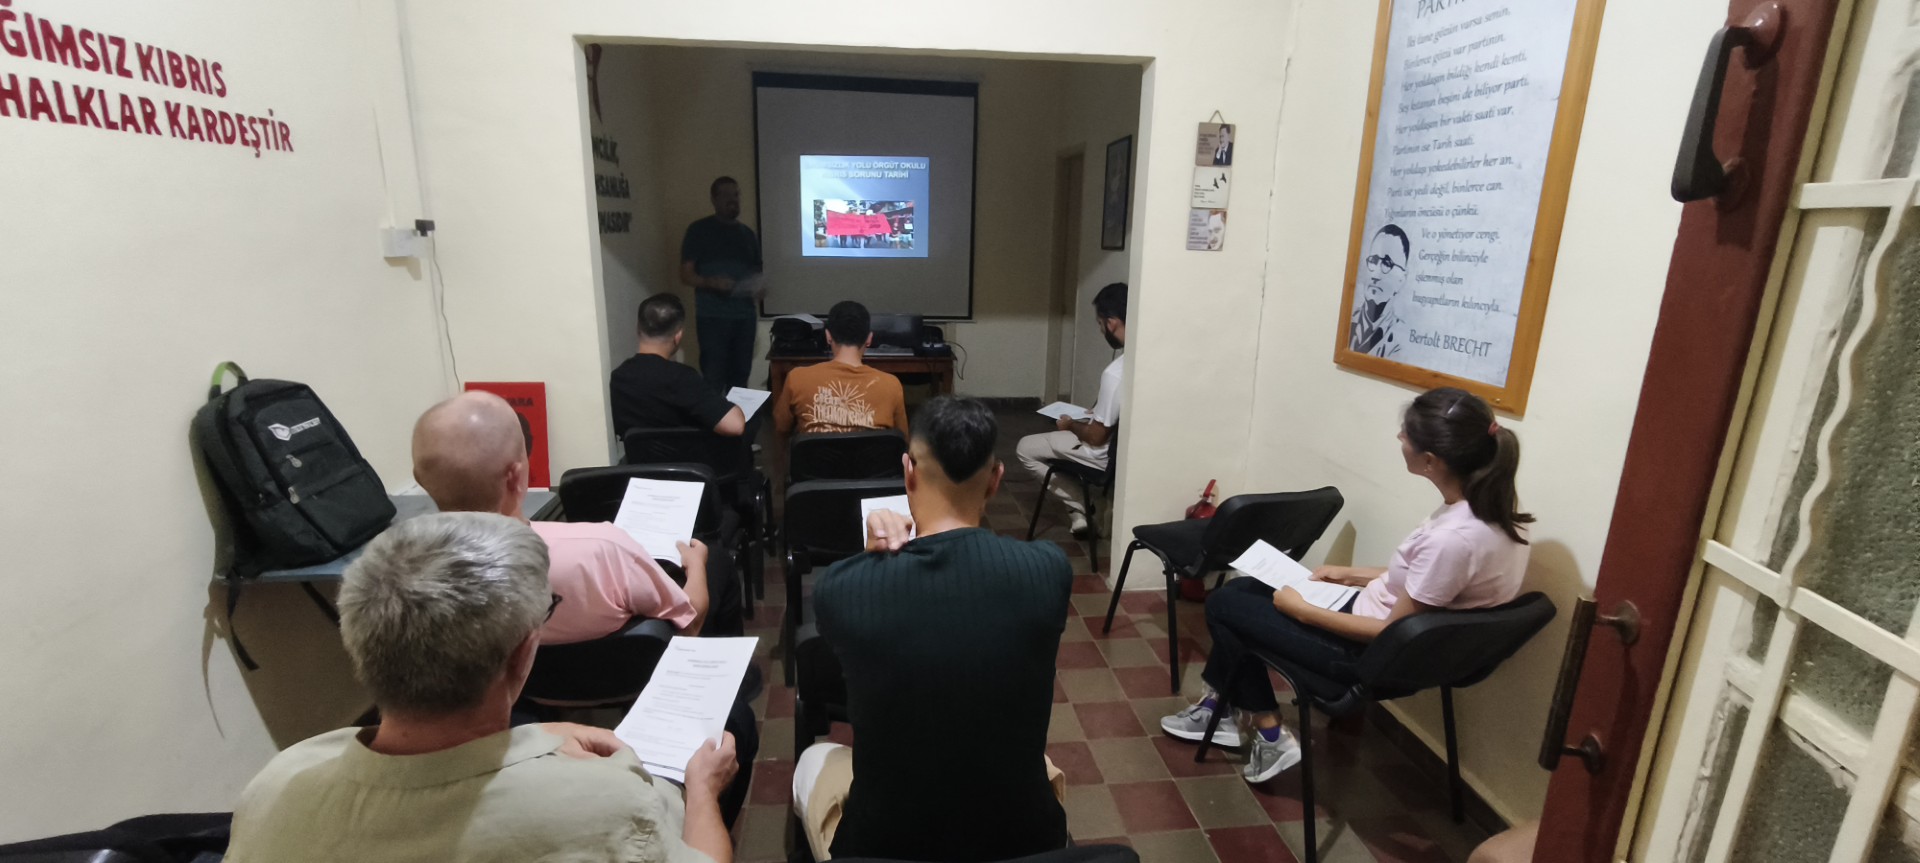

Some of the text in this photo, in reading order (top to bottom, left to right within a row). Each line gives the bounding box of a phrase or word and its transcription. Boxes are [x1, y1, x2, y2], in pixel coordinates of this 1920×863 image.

[1460, 17, 1482, 29] varsa
[1453, 45, 1467, 56] var
[135, 42, 227, 98] KIBRIS
[1474, 55, 1499, 73] kendi
[1462, 86, 1471, 100] de
[1474, 82, 1503, 100] biliyor
[0, 73, 294, 158] HALKLAR KARDEŞTİR
[1395, 126, 1408, 135] Her
[1440, 114, 1452, 127] bir
[1452, 110, 1472, 124] vakti
[1474, 106, 1495, 121] saati
[1421, 143, 1431, 152] ise
[1432, 135, 1452, 150] Tarih
[852, 161, 872, 169] YOLU
[900, 162, 926, 170] OKULU
[1390, 166, 1402, 177] Her
[1483, 153, 1498, 167] her
[1500, 156, 1514, 166] an.
[849, 170, 882, 178] SORUNU
[1387, 186, 1402, 197] Parti
[1403, 187, 1413, 197] ise
[1452, 180, 1484, 194] binlerce
[1486, 182, 1504, 192] can.
[1417, 206, 1444, 217] öncüsü
[1445, 208, 1450, 216] o
[1451, 203, 1479, 218] çünkü.
[1422, 228, 1430, 239] Ve
[1432, 231, 1437, 239] o
[1436, 228, 1475, 243] yönetiyor
[1418, 248, 1489, 267] Gerçeğin bilinciyle
[1415, 271, 1463, 286] işlenmiş olan
[1409, 329, 1493, 357] Bertolt BRECHT
